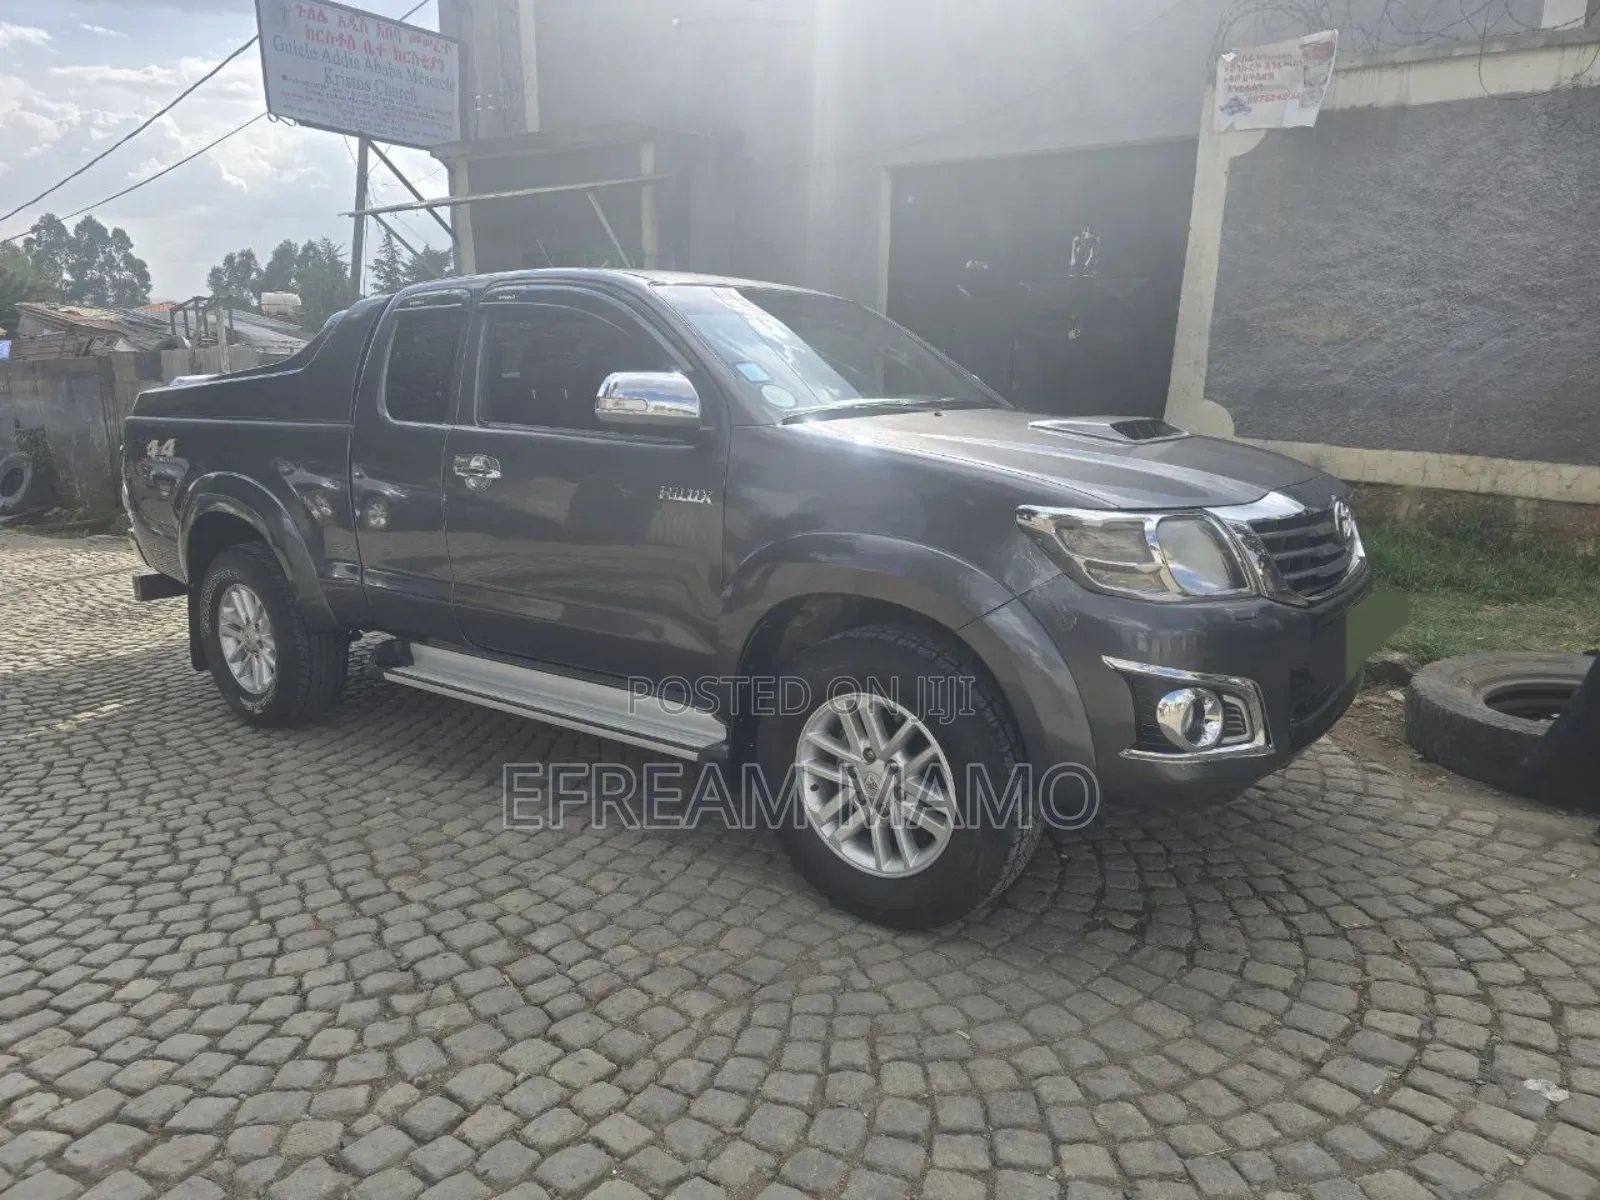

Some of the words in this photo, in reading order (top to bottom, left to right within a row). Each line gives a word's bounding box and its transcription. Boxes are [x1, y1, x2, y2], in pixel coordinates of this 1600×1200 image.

[305, 24, 356, 51] ክርስቶስ
[364, 40, 387, 58] ቤተ
[337, 14, 369, 36] አዲስ
[376, 21, 402, 42] አበባ
[273, 34, 318, 61] Gulele
[321, 47, 360, 70] Addis
[364, 57, 403, 80] Ababa
[324, 67, 371, 92] Kristos
[375, 79, 417, 102] Church
